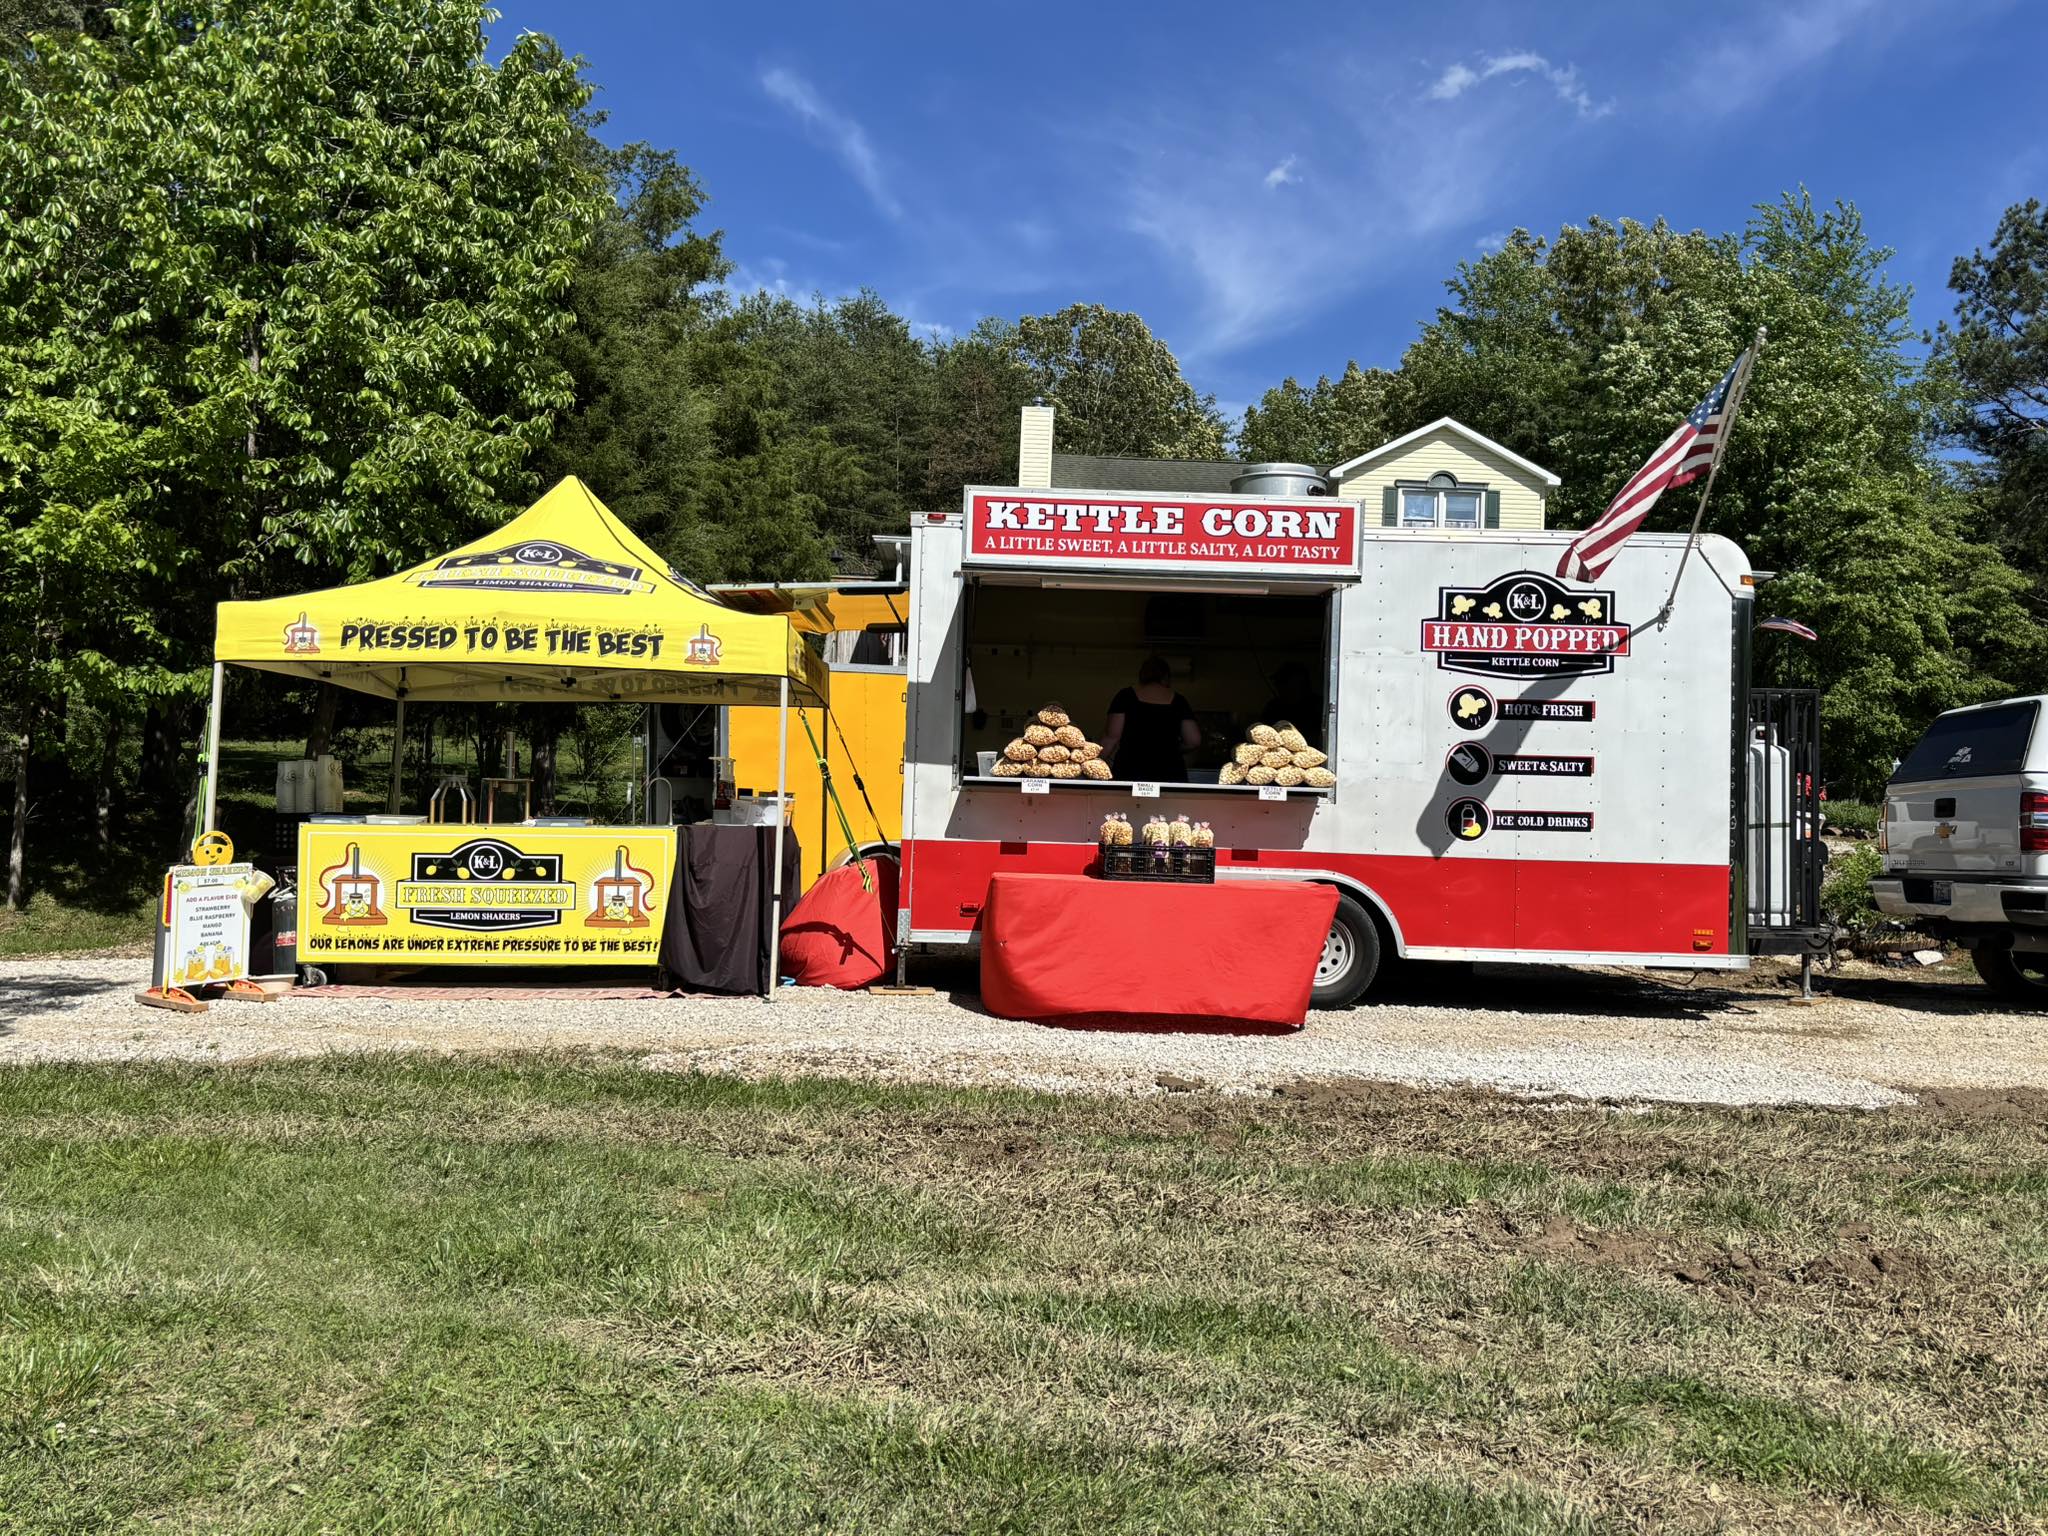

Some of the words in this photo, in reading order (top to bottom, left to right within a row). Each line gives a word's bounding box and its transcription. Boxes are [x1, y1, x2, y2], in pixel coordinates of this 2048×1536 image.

[985, 501, 1185, 535] KETTLE
[1201, 508, 1342, 540] CORN
[521, 549, 555, 560] K&L
[985, 536, 996, 549] A
[1000, 536, 1054, 551] LITTLE
[1058, 538, 1114, 554] SWEET,
[1117, 540, 1128, 553] A
[1131, 541, 1186, 555] LITTLE
[1190, 542, 1239, 558] SALTY,
[1242, 545, 1253, 557] A
[1257, 545, 1286, 558] LOT
[1290, 545, 1340, 560] TASTY
[474, 579, 517, 587] LEMON
[520, 581, 574, 589] SHAKERS
[1511, 593, 1541, 610] K&L
[340, 624, 457, 650] PRESSED
[464, 626, 498, 652] TO
[505, 627, 538, 652] BE
[545, 630, 591, 654] THE
[597, 632, 664, 658] BEST
[1432, 625, 1509, 649] HAND
[1515, 627, 1620, 652] POPPED
[1491, 657, 1530, 667] KETTLE
[1532, 658, 1560, 668] CORN
[1504, 704, 1531, 715] HOT
[1542, 705, 1583, 717] FRESH
[1498, 759, 1539, 772] SWEET
[1550, 761, 1585, 773] SALTY
[1496, 815, 1514, 825] ICE
[1518, 815, 1544, 826] COLD
[1547, 816, 1588, 828] DRINKS
[473, 855, 499, 869] K&L
[403, 886, 466, 904] FRESH
[471, 887, 569, 906] SQUEEZED
[195, 904, 231, 913] STRAWBERRY
[205, 913, 236, 921] RASPBERRY
[450, 912, 480, 920] LEMON
[481, 912, 521, 921] SHAKERS
[310, 938, 332, 950] OUR
[335, 938, 379, 951] LEMONS
[383, 938, 404, 950] ARE
[407, 939, 444, 951] UNDER
[447, 939, 500, 952] EXTREME
[502, 940, 561, 952] PRESSURE
[564, 941, 579, 952] TO
[582, 940, 597, 952] BE
[600, 941, 619, 952] THE
[623, 941, 658, 953] BEST!
